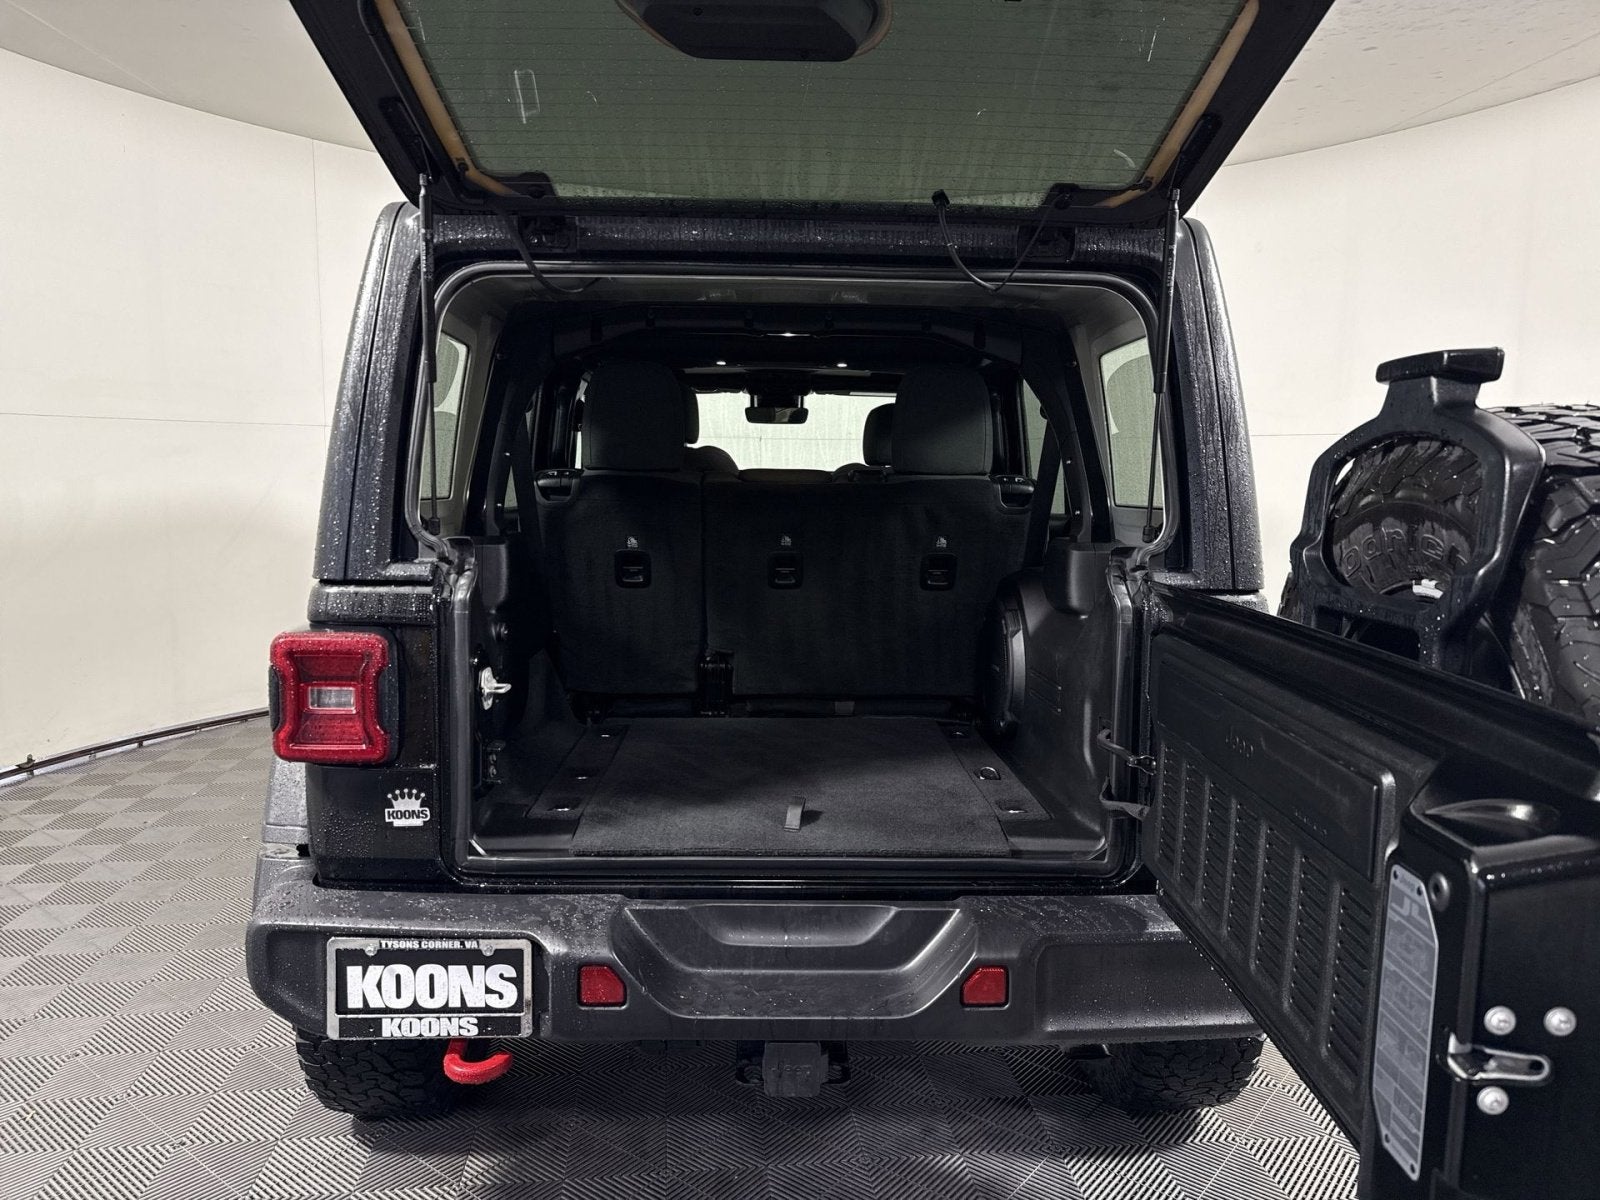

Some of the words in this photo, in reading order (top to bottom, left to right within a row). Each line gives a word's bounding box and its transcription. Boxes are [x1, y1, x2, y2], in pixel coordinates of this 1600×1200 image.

[387, 809, 429, 820] KOONS
[381, 940, 419, 949] TYSONS
[464, 940, 478, 949] VA
[346, 963, 518, 1009] KOONS
[382, 1017, 479, 1037] KOONS
